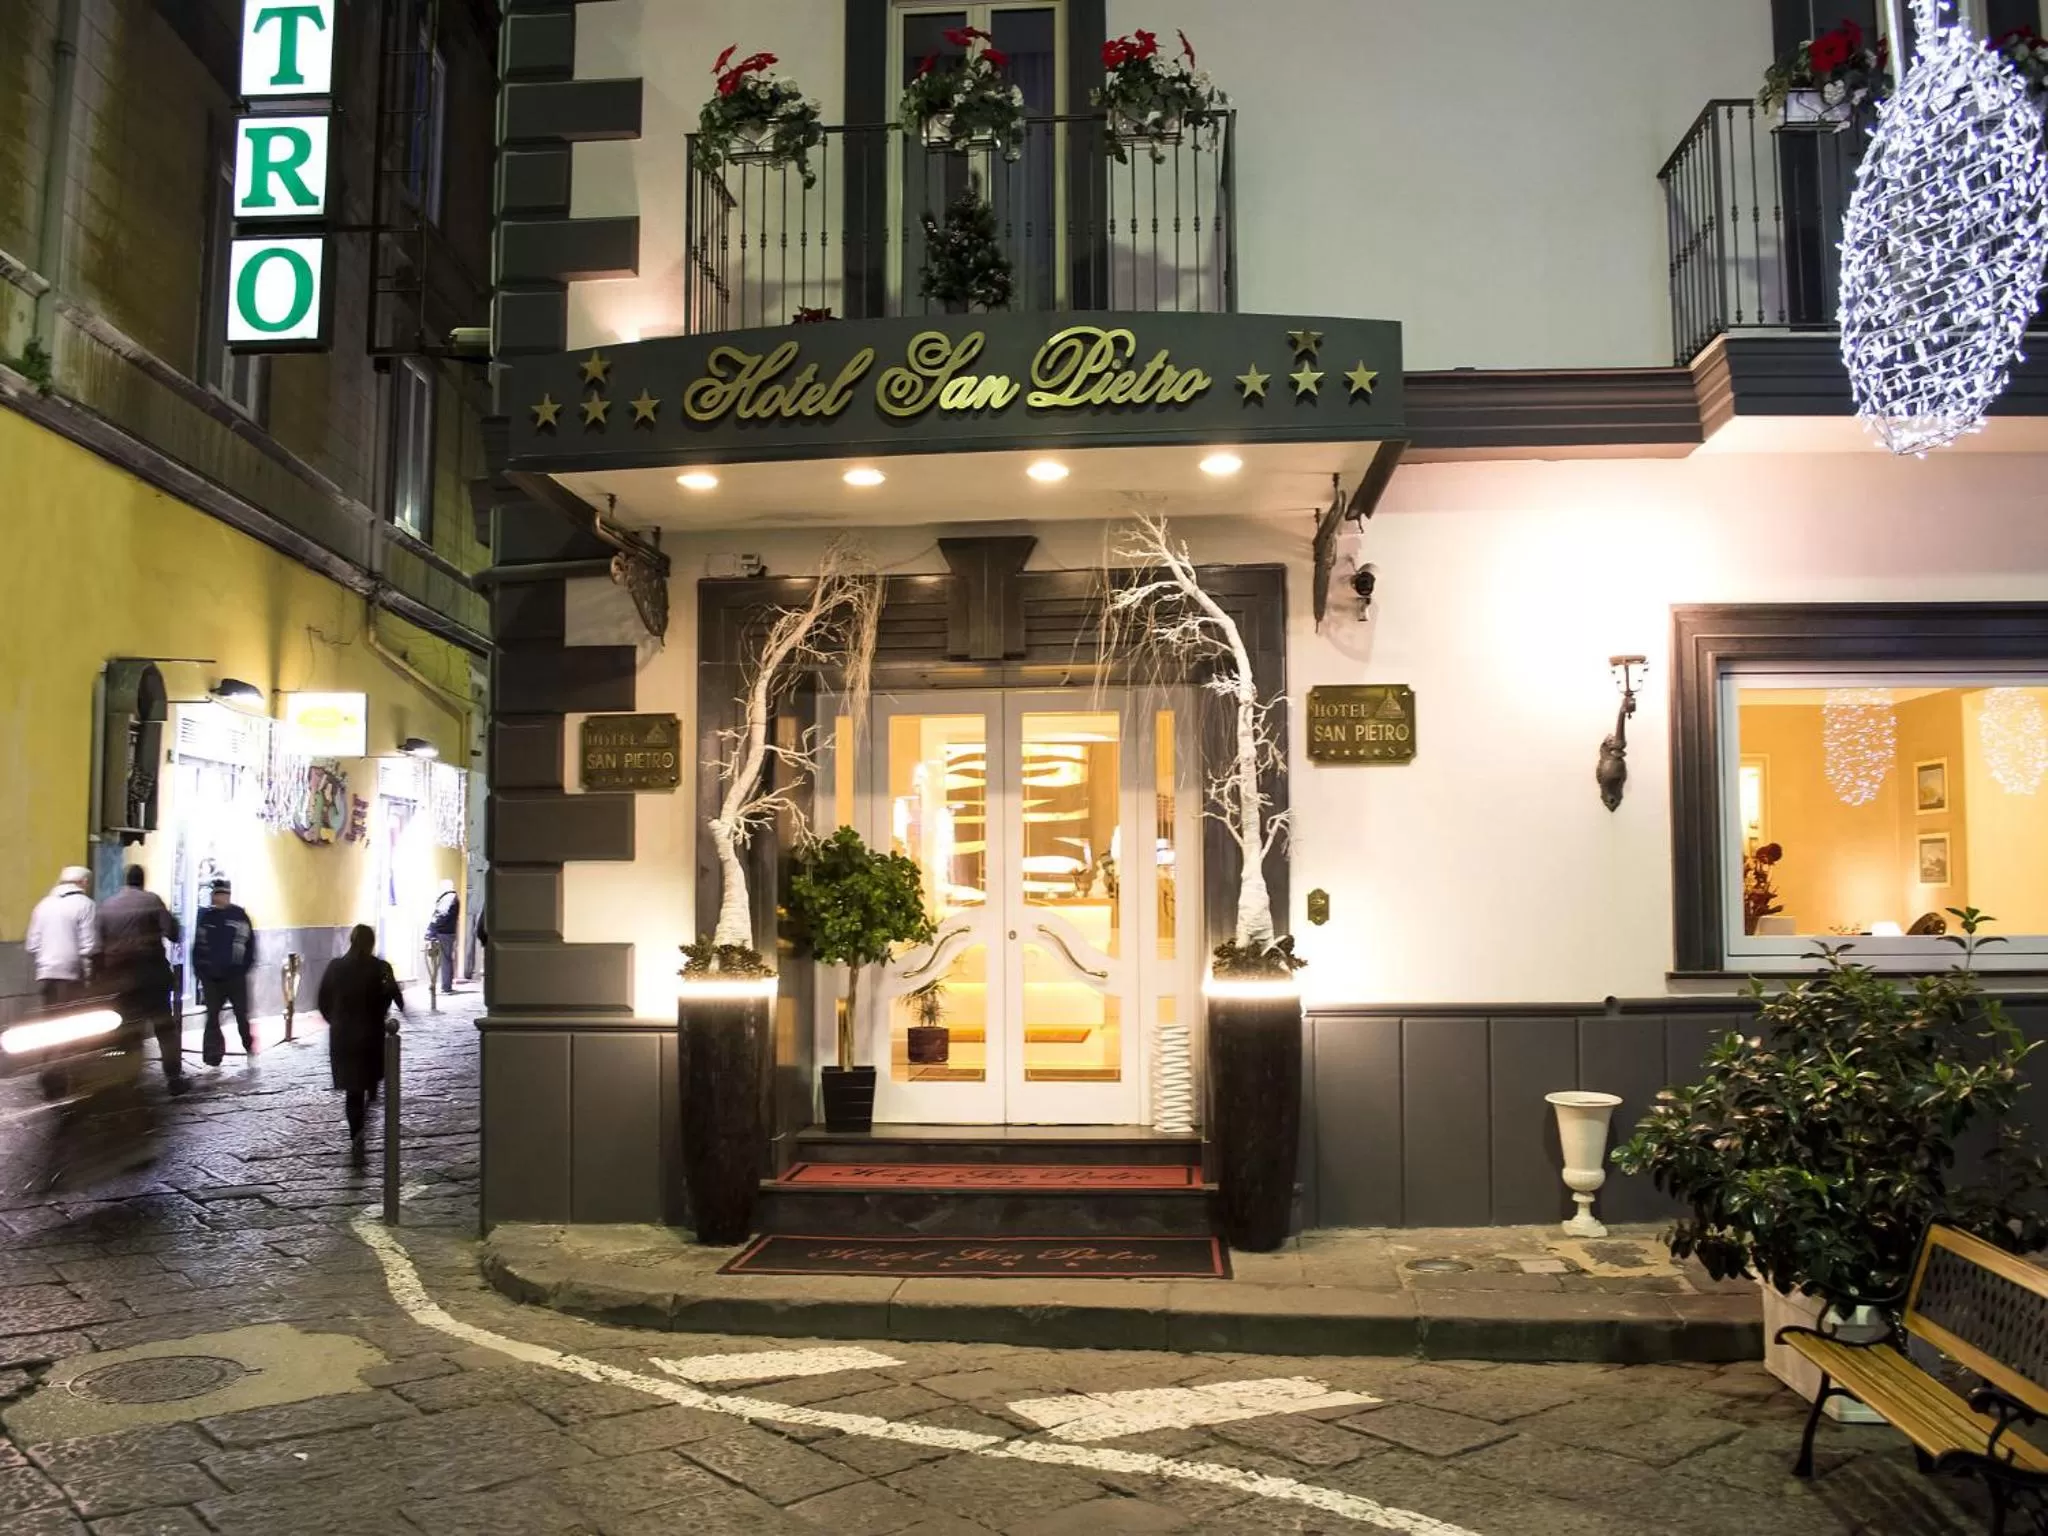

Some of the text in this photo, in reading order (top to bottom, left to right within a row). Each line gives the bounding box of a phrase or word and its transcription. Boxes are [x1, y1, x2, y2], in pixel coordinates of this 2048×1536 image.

[684, 325, 1213, 422] Hotel San Pietro
[1313, 702, 1369, 718] HOTEL
[1314, 723, 1410, 742] SAN PIETRO
[587, 751, 675, 769] SAN PIETRO
